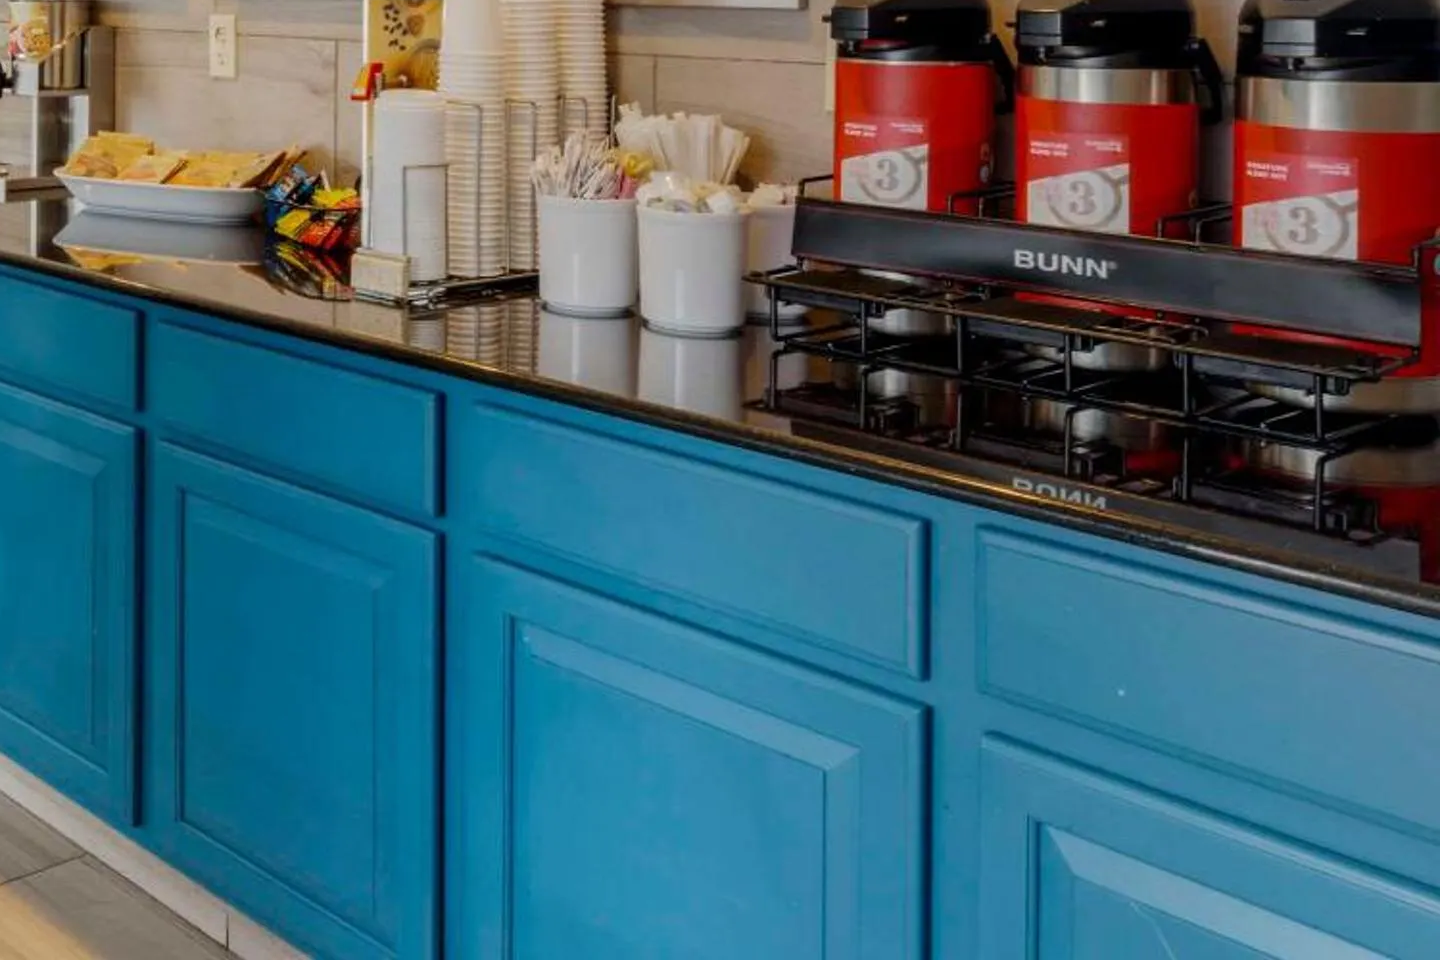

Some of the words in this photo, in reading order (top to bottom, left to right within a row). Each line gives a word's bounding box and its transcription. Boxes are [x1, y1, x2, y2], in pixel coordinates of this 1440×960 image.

[876, 158, 900, 191] 3
[1068, 180, 1097, 215] 3
[1287, 206, 1320, 245] 3
[1013, 249, 1108, 279] BUNN
